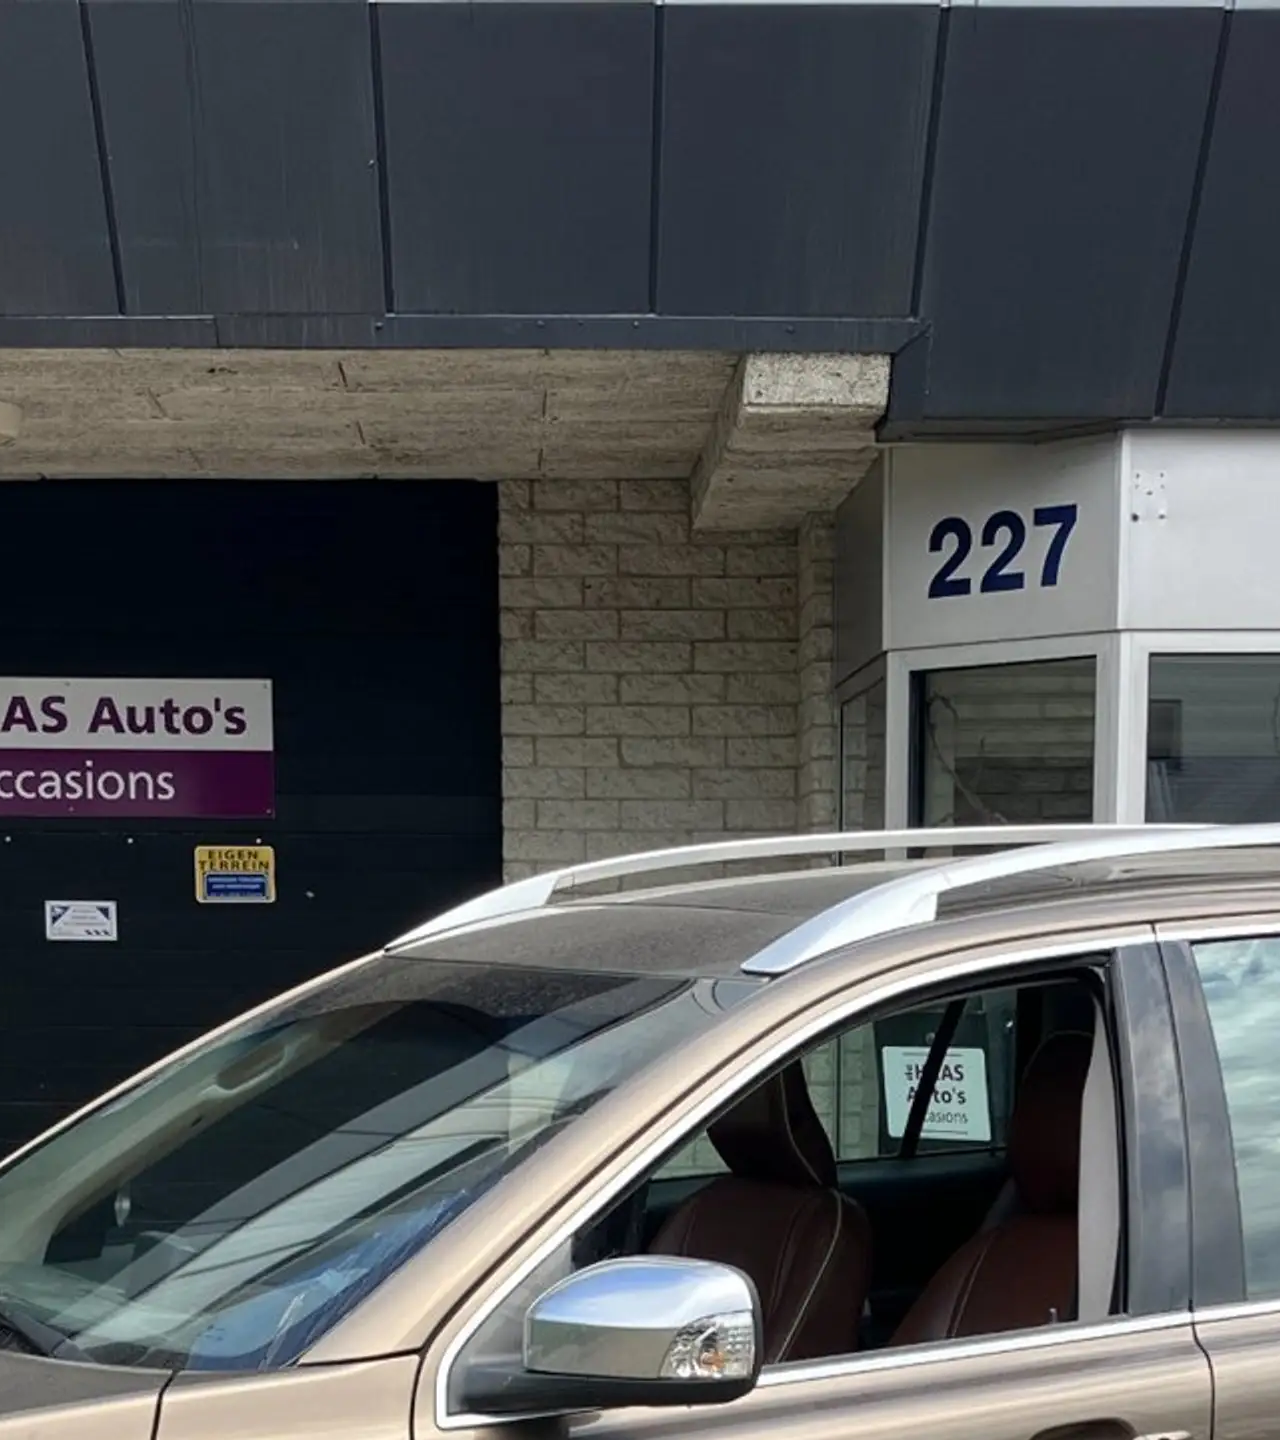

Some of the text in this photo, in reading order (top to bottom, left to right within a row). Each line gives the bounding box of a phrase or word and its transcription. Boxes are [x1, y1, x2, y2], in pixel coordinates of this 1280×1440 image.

[926, 503, 1079, 599] 227
[87, 696, 247, 736] Auto's
[207, 849, 259, 860] EIGEN
[199, 860, 270, 871] TERREIN
[915, 1064, 964, 1081] HAS
